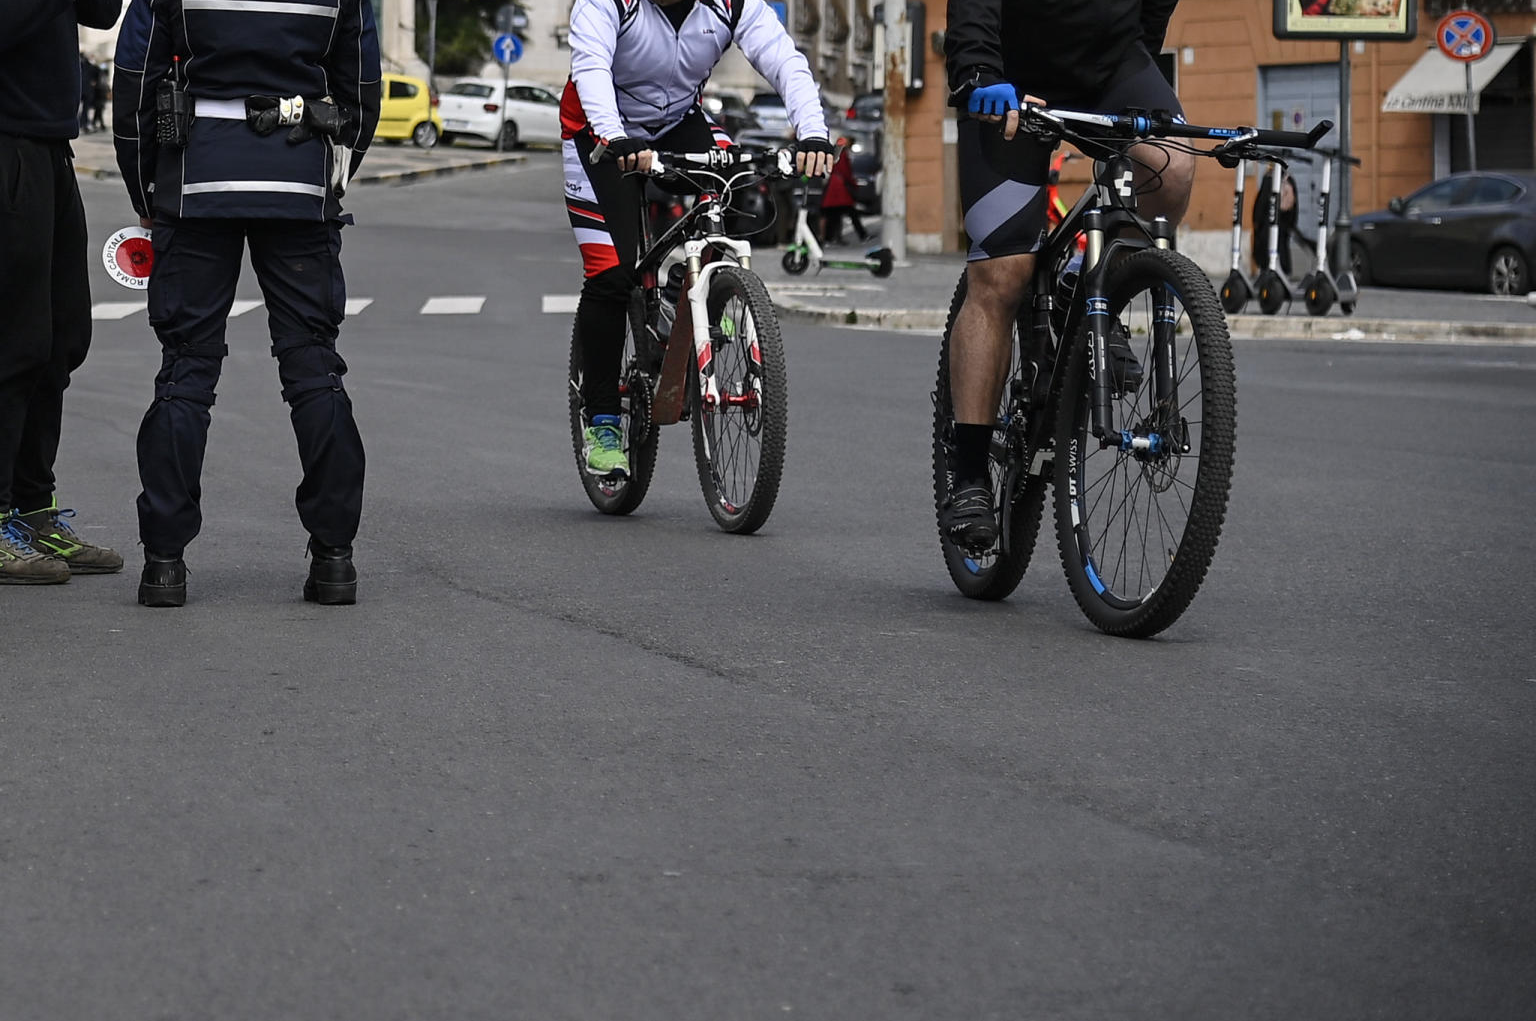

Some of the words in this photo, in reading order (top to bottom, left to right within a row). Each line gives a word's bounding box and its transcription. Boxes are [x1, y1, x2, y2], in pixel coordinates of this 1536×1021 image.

[106, 232, 127, 271] CAPITALE
[116, 271, 144, 286] ROMA
[1068, 438, 1078, 475] SWISS
[1068, 476, 1078, 496] DT
